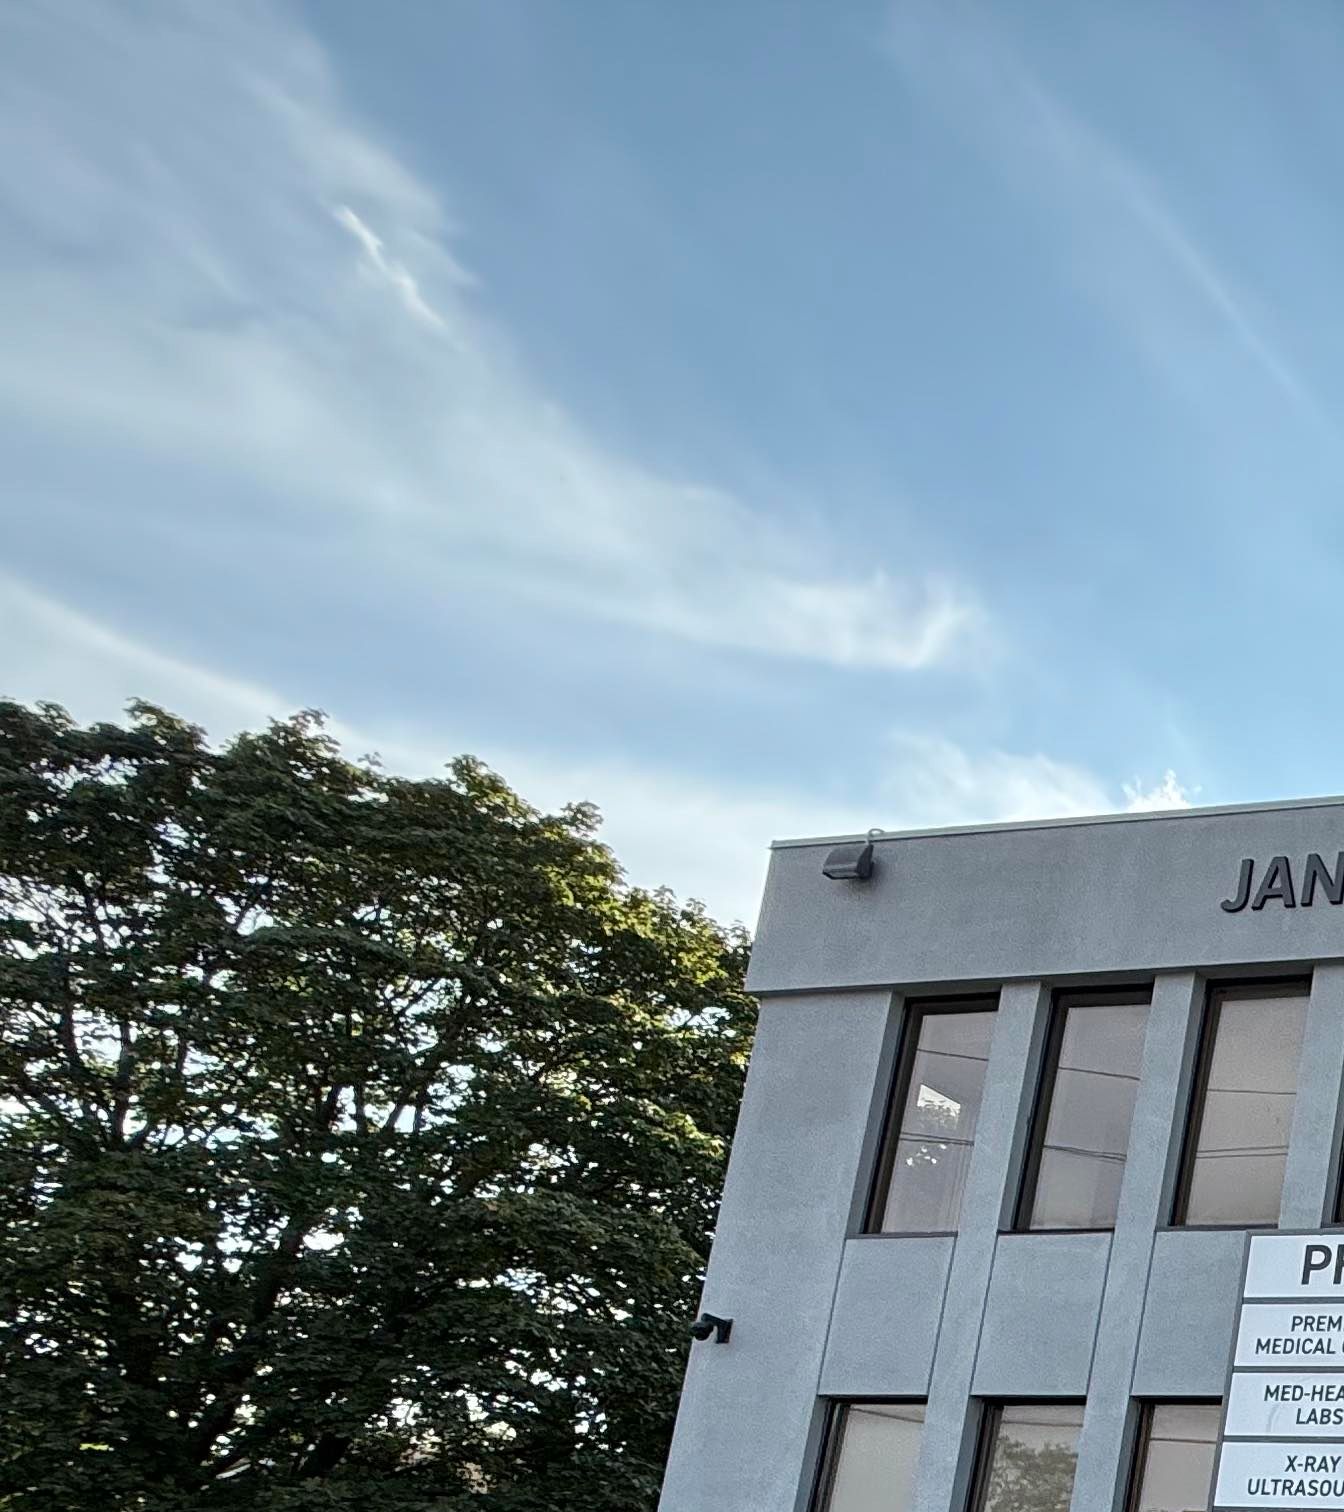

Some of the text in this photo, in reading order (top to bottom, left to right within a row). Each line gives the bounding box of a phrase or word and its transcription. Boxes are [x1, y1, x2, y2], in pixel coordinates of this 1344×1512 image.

[1255, 1337, 1336, 1355] MEDICAL
[1295, 1407, 1344, 1425] LABS
[1284, 1455, 1342, 1473] X-RAY
